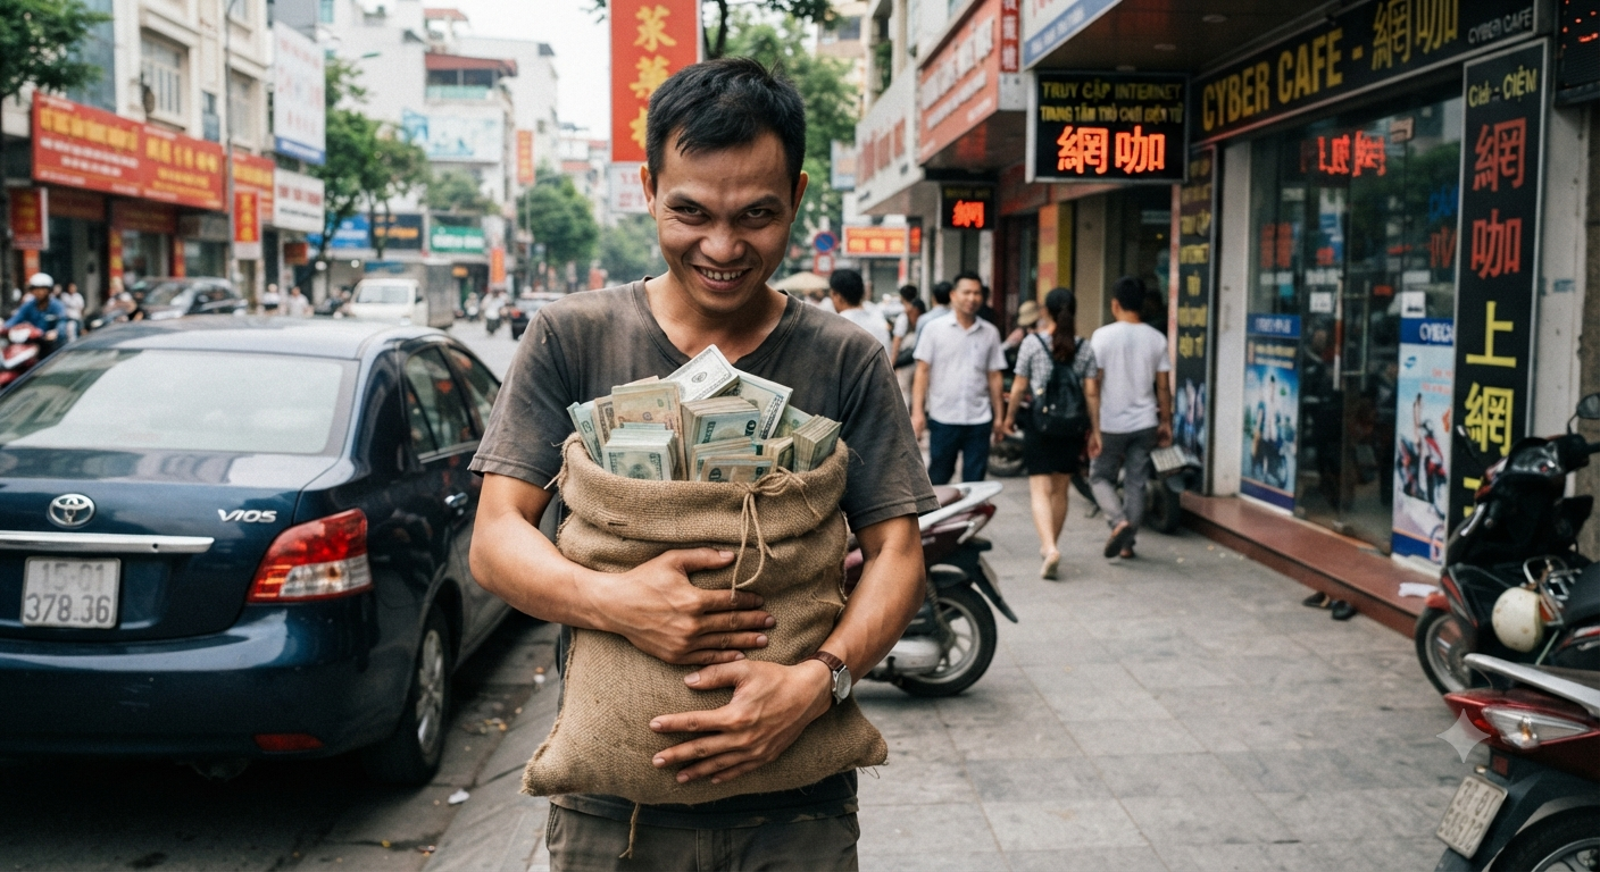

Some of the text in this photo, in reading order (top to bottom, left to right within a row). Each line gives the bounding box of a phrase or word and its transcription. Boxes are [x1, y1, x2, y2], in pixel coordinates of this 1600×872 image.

[1042, 82, 1079, 99] TRUY
[1115, 81, 1183, 100] INTERNET
[1203, 60, 1270, 132] CYBER
[1277, 27, 1343, 105] CAFE
[1056, 125, 1166, 175] 網咖
[1472, 116, 1527, 281] 網咖
[1463, 300, 1518, 519] 上網
[217, 508, 278, 523] VIOS
[25, 592, 111, 624] 378.36
